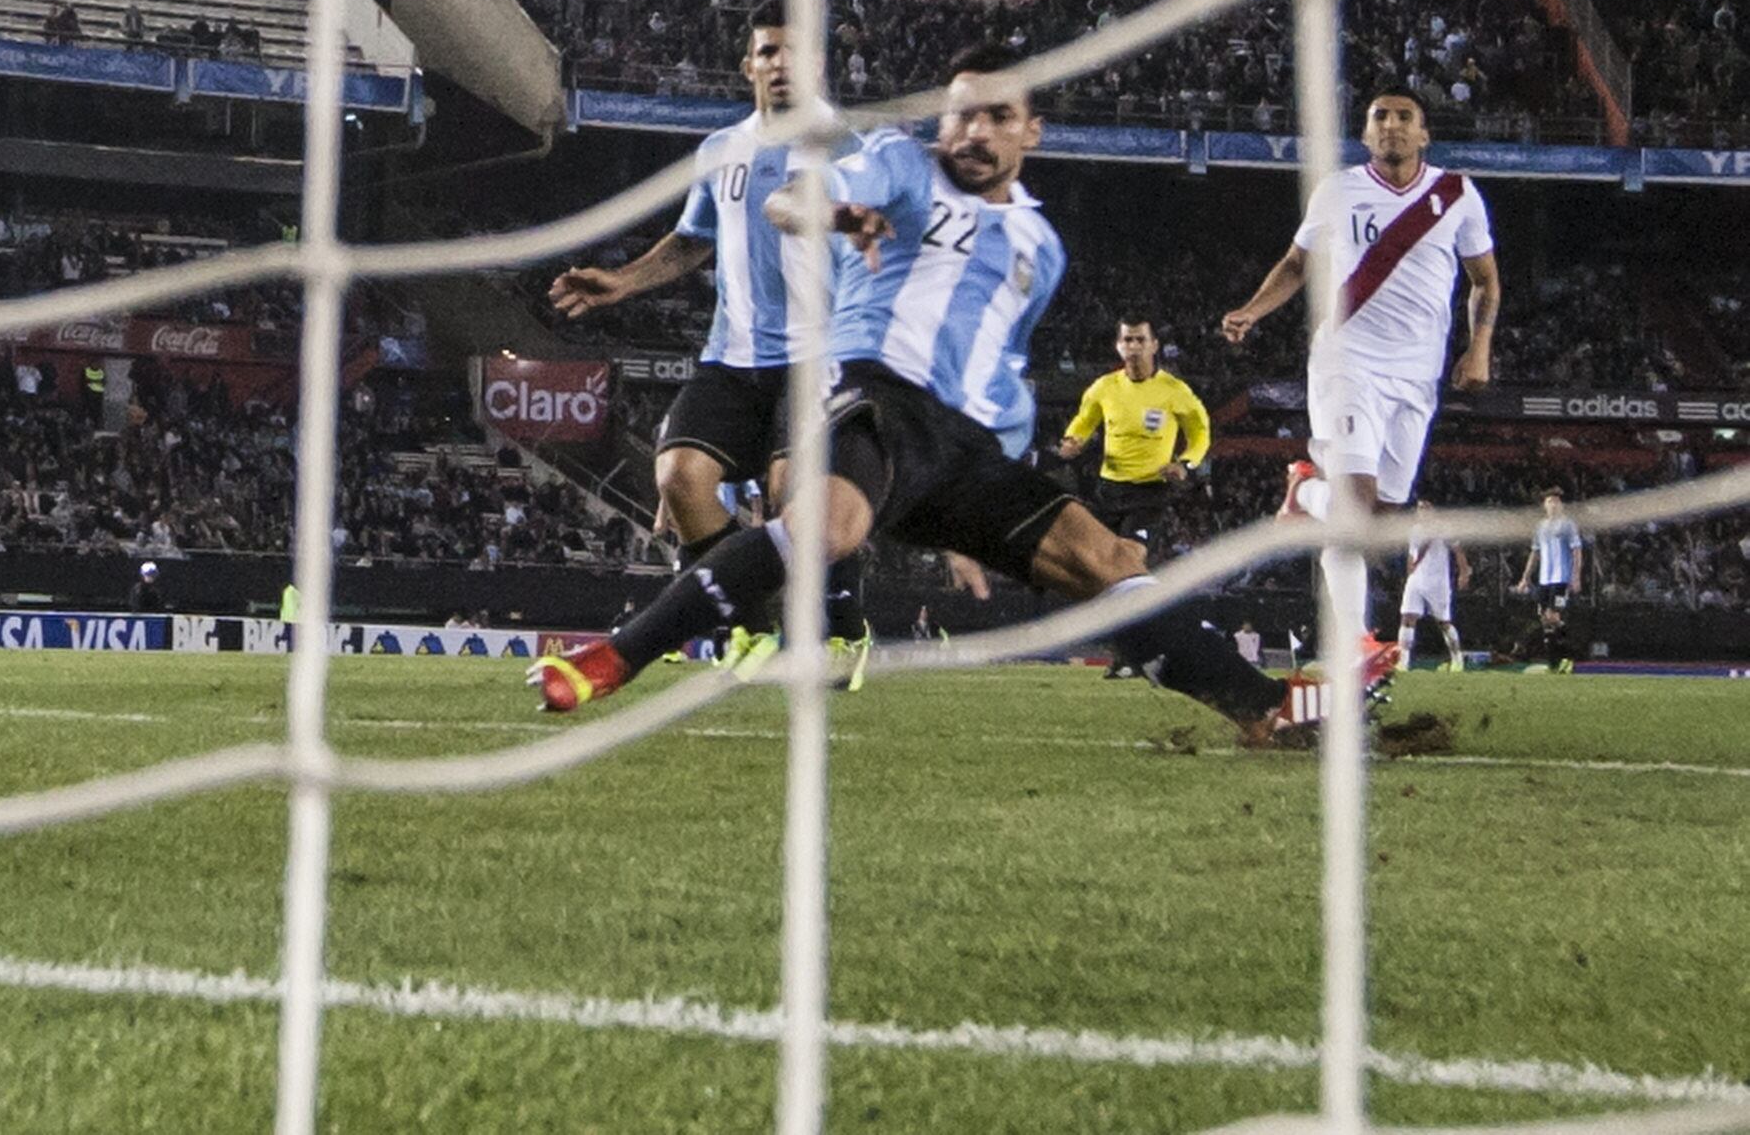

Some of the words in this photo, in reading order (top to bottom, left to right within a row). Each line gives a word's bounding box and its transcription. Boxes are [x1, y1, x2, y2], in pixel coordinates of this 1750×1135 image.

[720, 163, 748, 203] 10
[921, 201, 979, 255] 22
[1352, 213, 1379, 245] 16
[654, 357, 694, 381] adi
[484, 380, 598, 425] Claro
[1567, 395, 1660, 419] adidas
[66, 618, 147, 651] VISA
